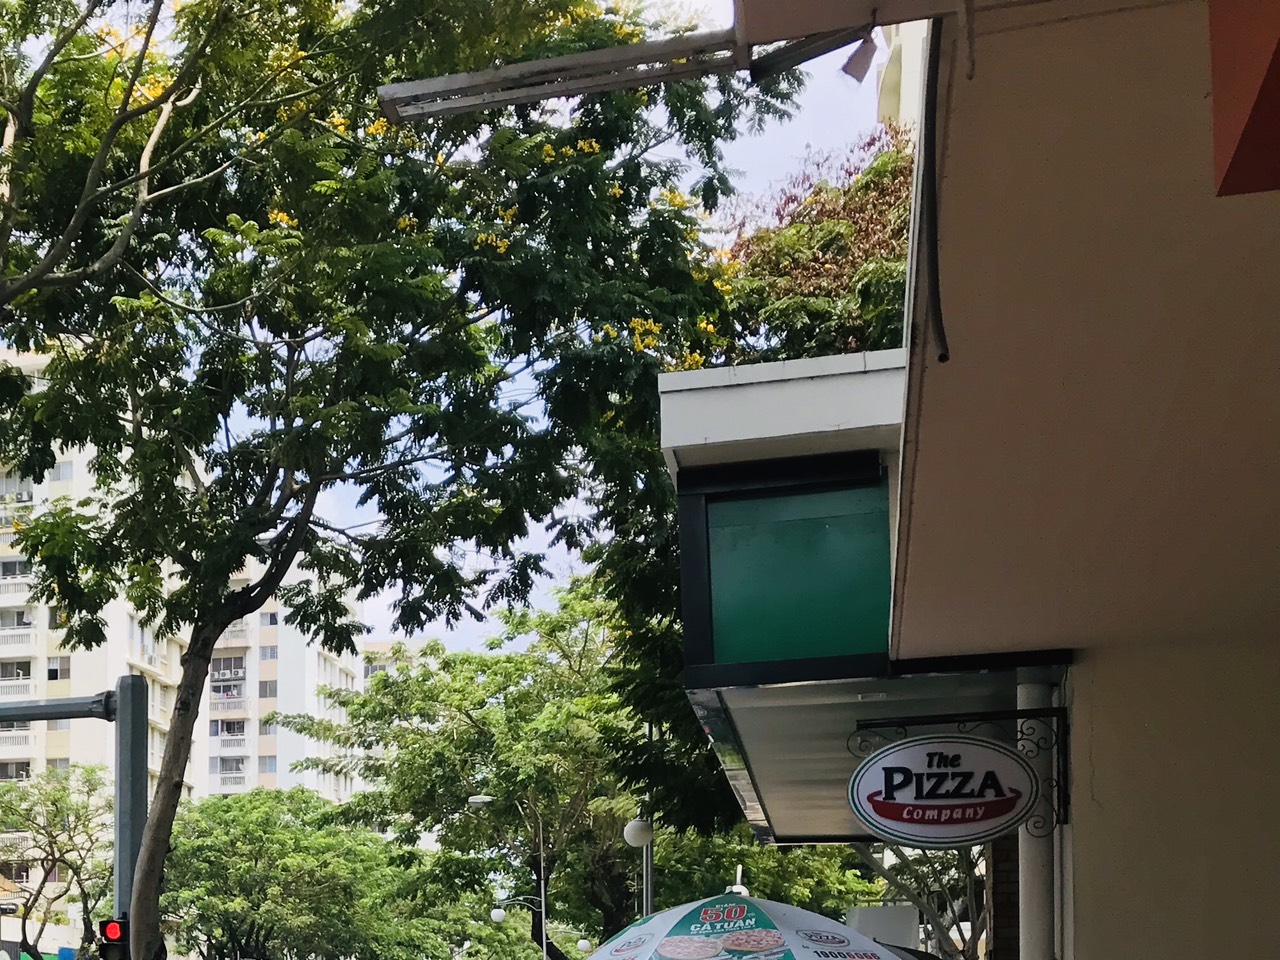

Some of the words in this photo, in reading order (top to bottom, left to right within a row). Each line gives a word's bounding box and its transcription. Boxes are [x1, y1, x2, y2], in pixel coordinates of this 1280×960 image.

[926, 751, 962, 768] The
[881, 766, 1007, 801] PIZZA
[902, 805, 985, 821] Company
